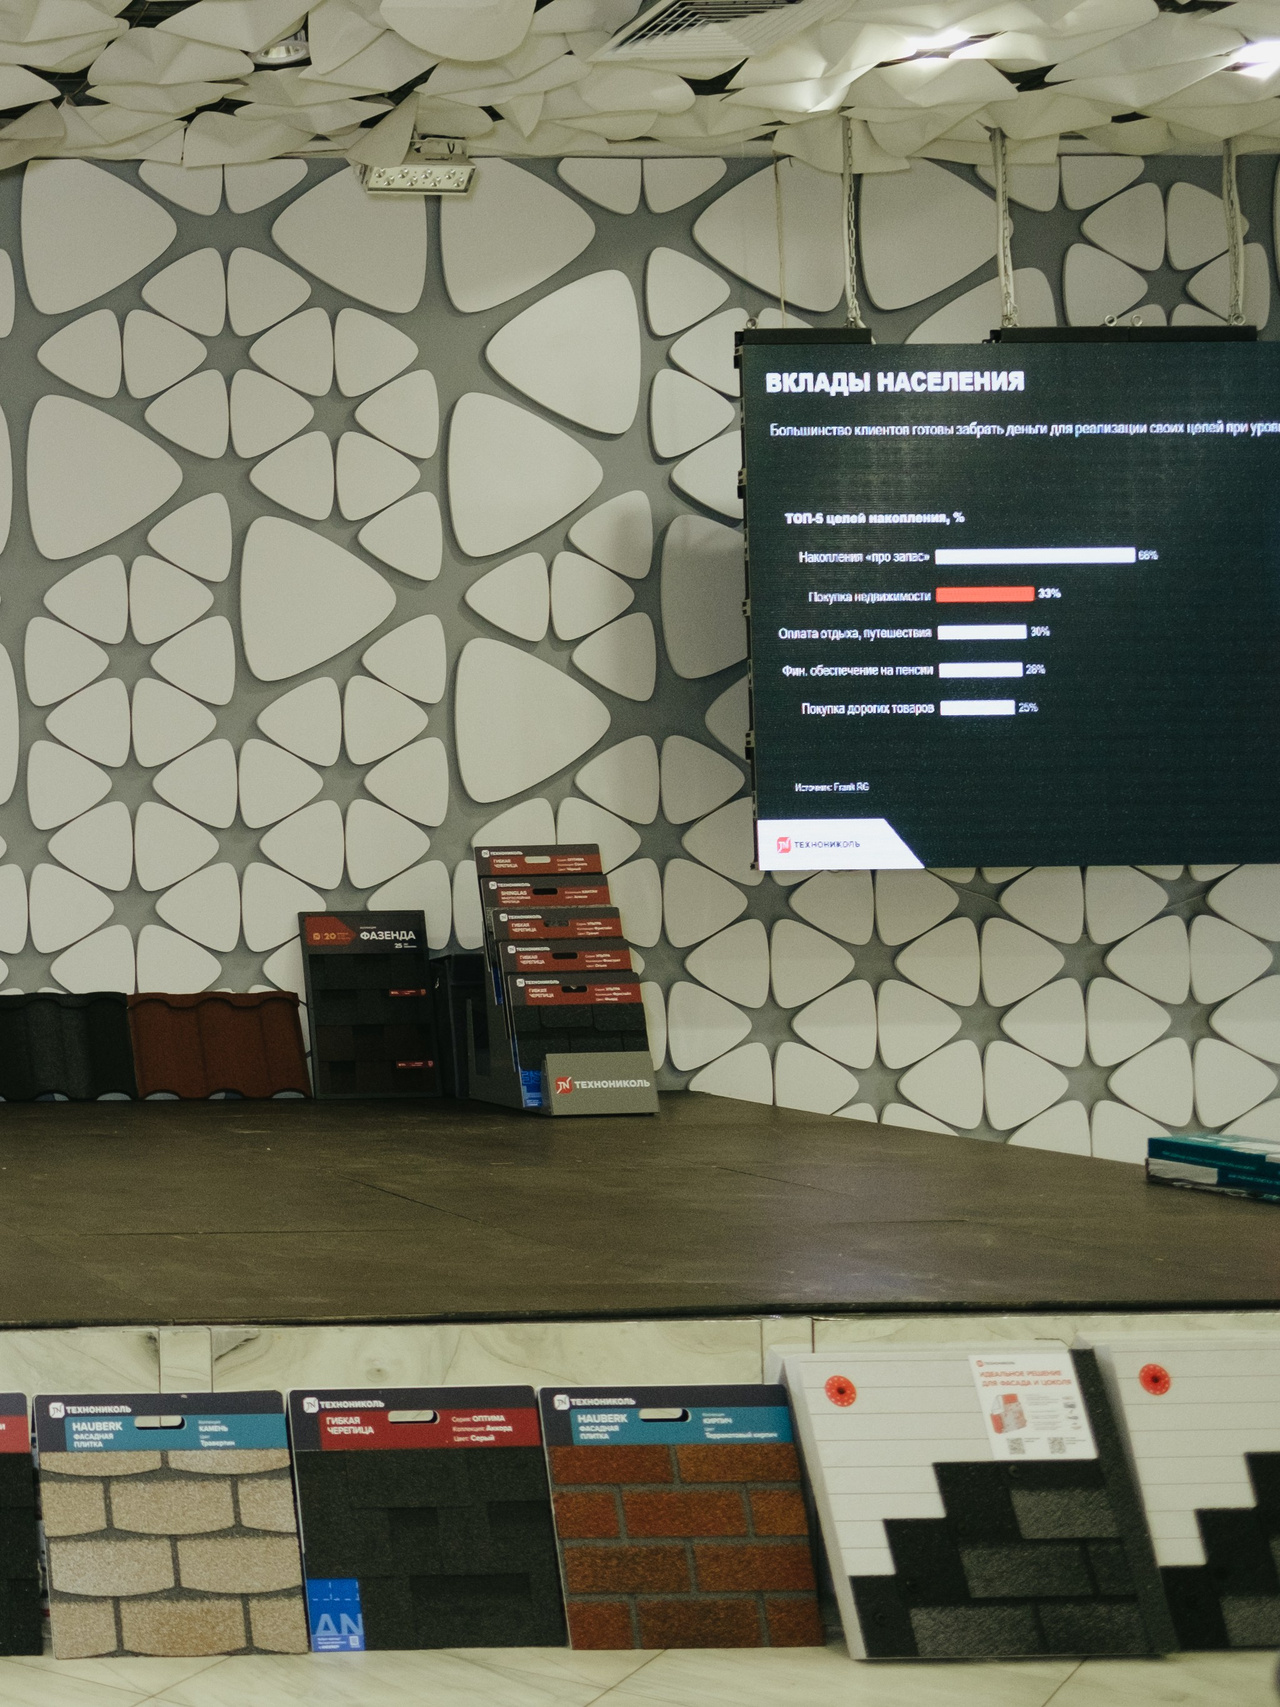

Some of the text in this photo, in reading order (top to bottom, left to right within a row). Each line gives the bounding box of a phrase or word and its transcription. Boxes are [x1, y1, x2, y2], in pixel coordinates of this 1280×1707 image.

[766, 371, 1025, 396] ВКЛАДЫ НАСЕЛЕНИЯ
[770, 423, 852, 436] Большинство
[854, 425, 910, 436] клиентов
[912, 425, 954, 436] готовы
[956, 422, 1004, 438] забрать
[1006, 423, 1047, 436] деньги
[1049, 424, 1073, 436] для
[1075, 423, 1147, 437] реализации
[1149, 423, 1184, 433] своих
[1187, 420, 1224, 435] целей
[1226, 423, 1249, 436] при
[785, 513, 823, 524] ТОП-5
[826, 513, 866, 525] целей
[953, 511, 965, 523] %
[799, 552, 863, 563] Накопления
[809, 588, 1061, 604] Покупка недвижимости 33%
[778, 628, 819, 639] Оплата
[863, 628, 932, 641] путешествия
[782, 665, 807, 676] Фин.
[810, 665, 878, 676] обеспечение
[880, 666, 894, 675] на
[895, 665, 933, 675] пенсии
[801, 703, 845, 716] Покупка
[847, 704, 890, 716] дорогих
[891, 704, 935, 716] товаров
[360, 931, 416, 940] ФАЗЕНДА
[574, 1080, 650, 1089] ТЕХНОНИКОЛЬ
[320, 1400, 385, 1409] ТЕХНОНИКОЛЬ
[570, 1398, 636, 1406] ТЕХНОНИКОЛЬ
[66, 1405, 131, 1414] ТЕХНОНИКОЛЬ
[326, 1416, 361, 1425] ГИБКАЯ
[472, 1414, 506, 1422] ОПТИМА
[577, 1413, 628, 1423] HAUBERK
[72, 1421, 123, 1431] HAUBERK
[327, 1426, 374, 1435] ЧЕРЕПИЦА
[73, 1432, 114, 1440] ФАСАДНАЯ
[470, 1434, 495, 1442] Серый
[74, 1440, 103, 1448] ПЛИТКА
